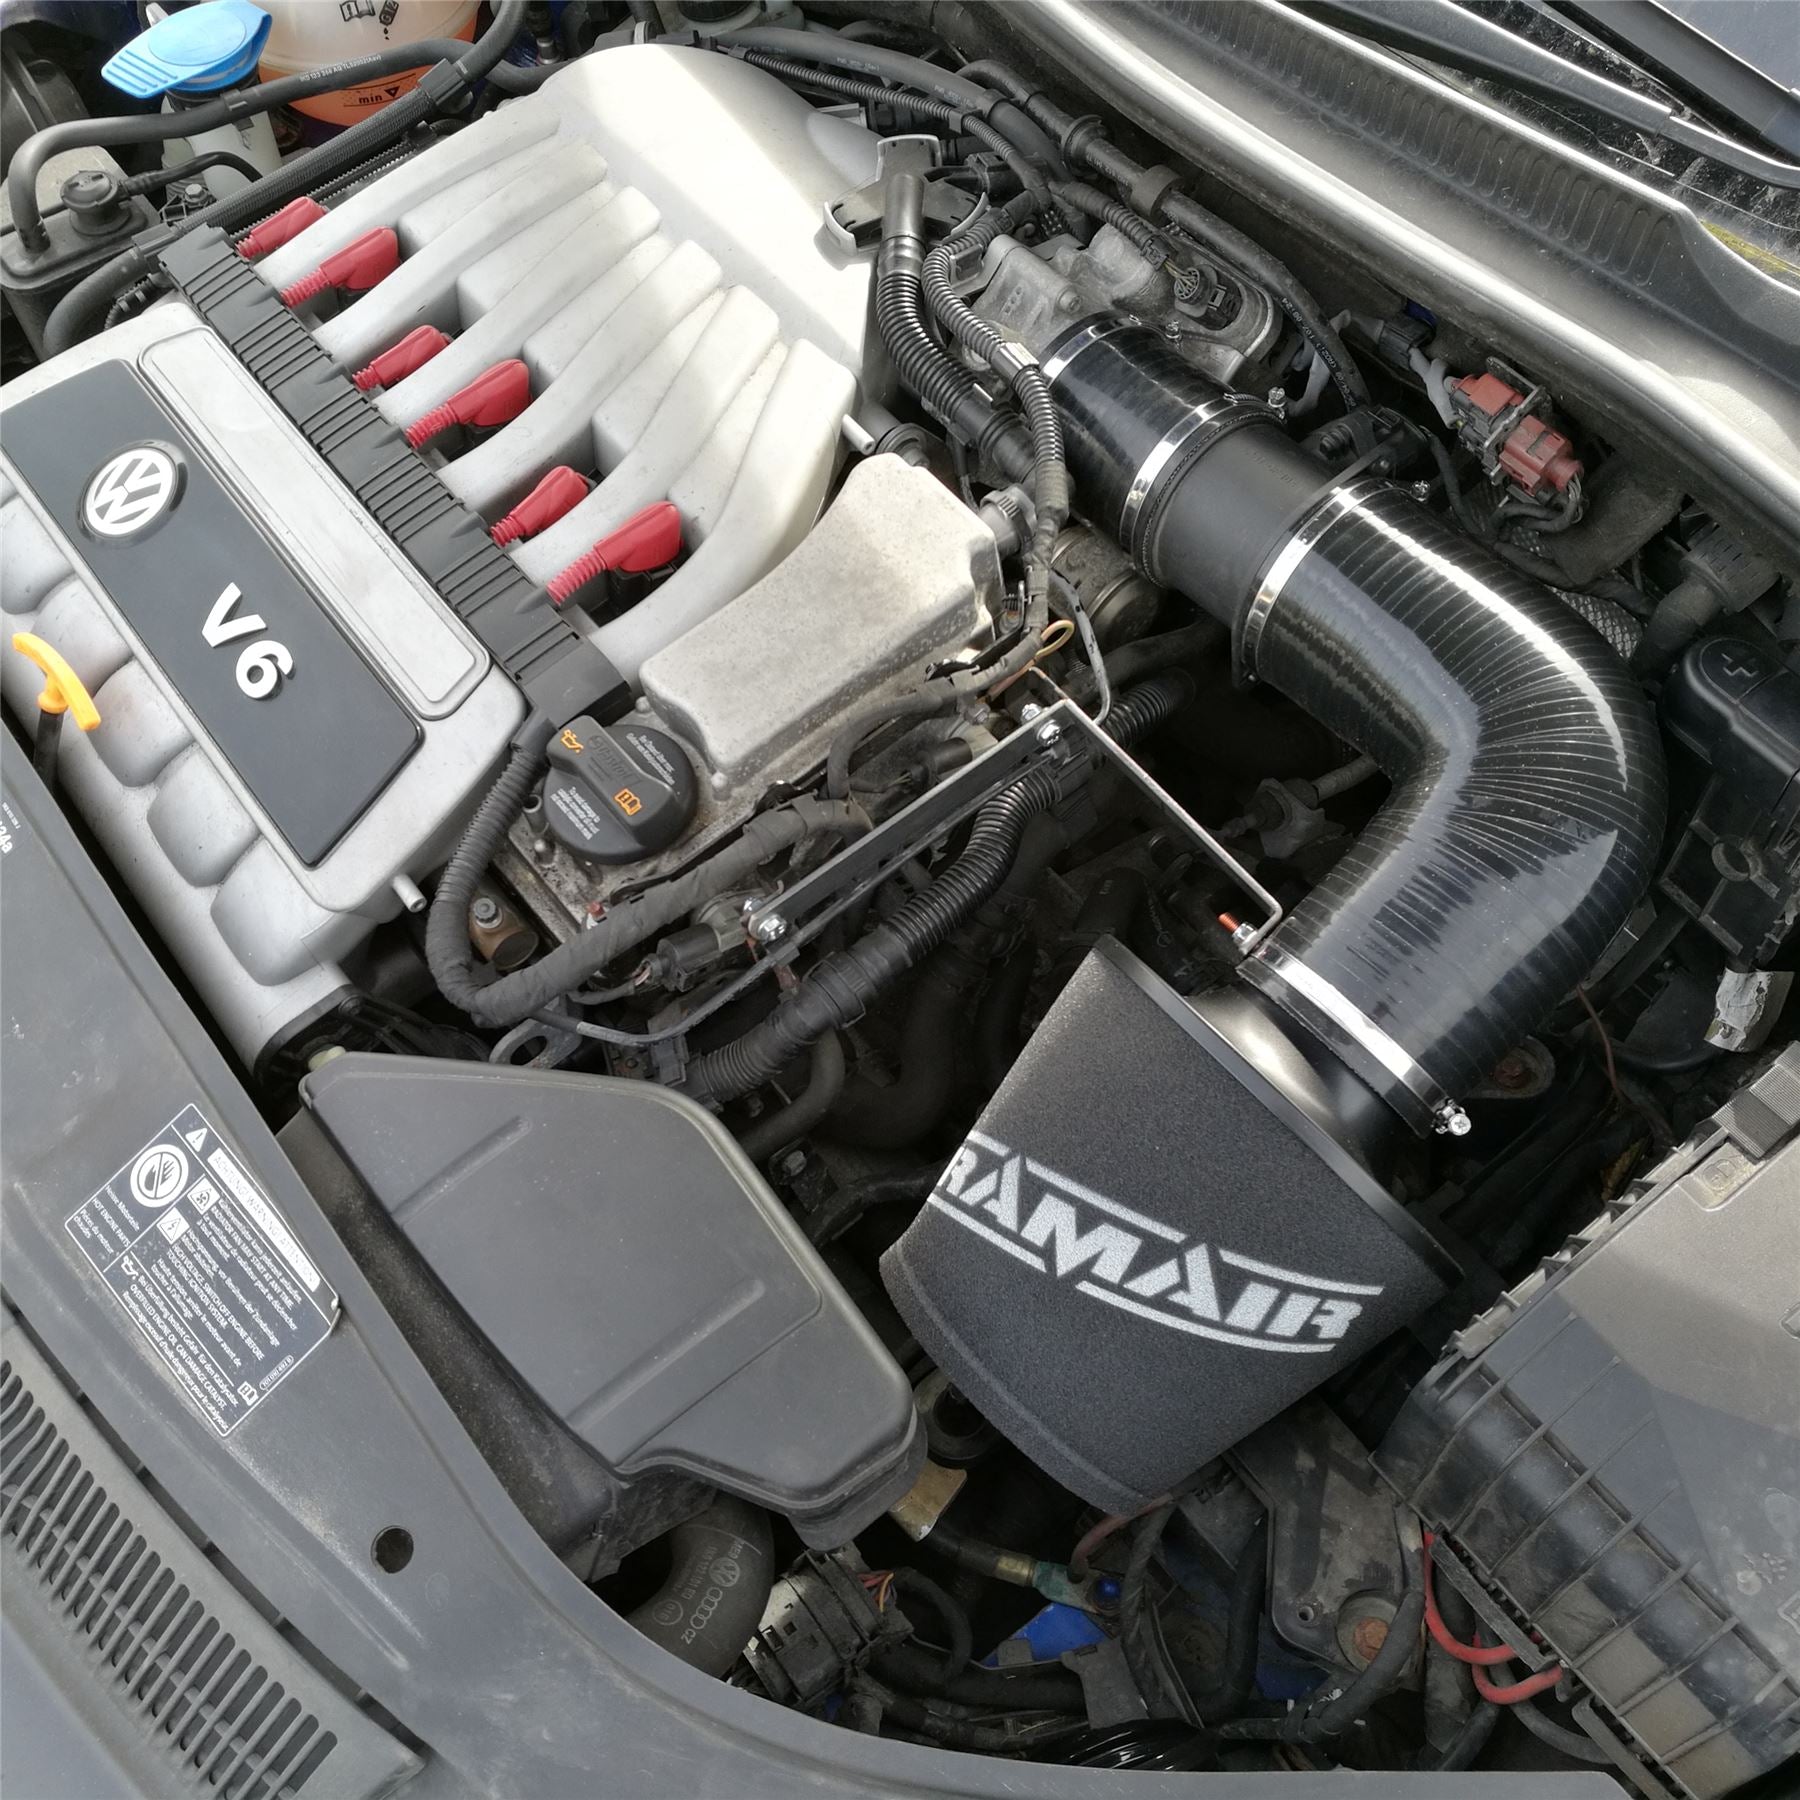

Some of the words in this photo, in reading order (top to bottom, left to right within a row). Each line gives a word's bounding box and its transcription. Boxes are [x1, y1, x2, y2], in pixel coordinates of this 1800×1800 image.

[359, 93, 382, 104] min
[201, 581, 294, 699] V6
[91, 1196, 104, 1212] HOT
[99, 1208, 119, 1232] ENGINE
[114, 1228, 131, 1247] PARTS
[937, 1146, 1362, 1340] RAMAIR
